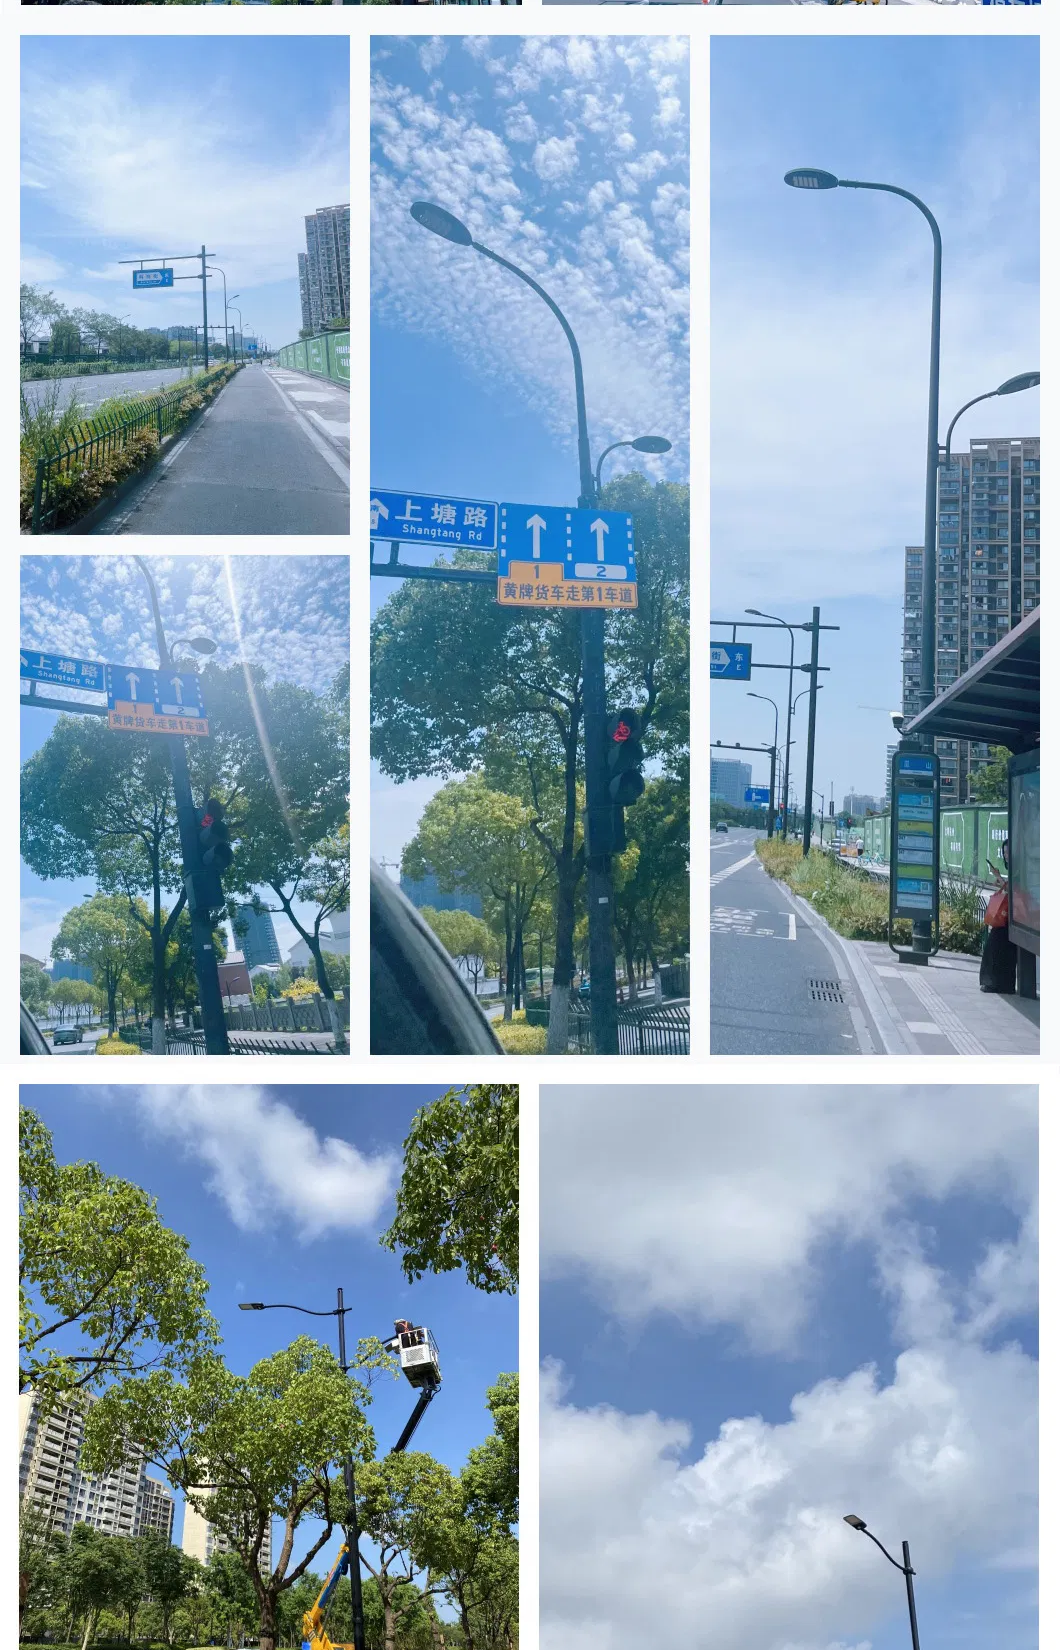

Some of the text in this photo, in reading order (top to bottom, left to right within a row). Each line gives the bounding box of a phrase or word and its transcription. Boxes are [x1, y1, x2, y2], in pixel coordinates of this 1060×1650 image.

[394, 499, 488, 528] 上塘路
[402, 523, 482, 541] Shangtang Rd
[534, 565, 539, 579] 1
[596, 566, 607, 577] 2
[503, 582, 633, 603] 黄牌货车走第1车道
[32, 656, 98, 678] 上塘路
[37, 671, 95, 686] Shangtang Rd
